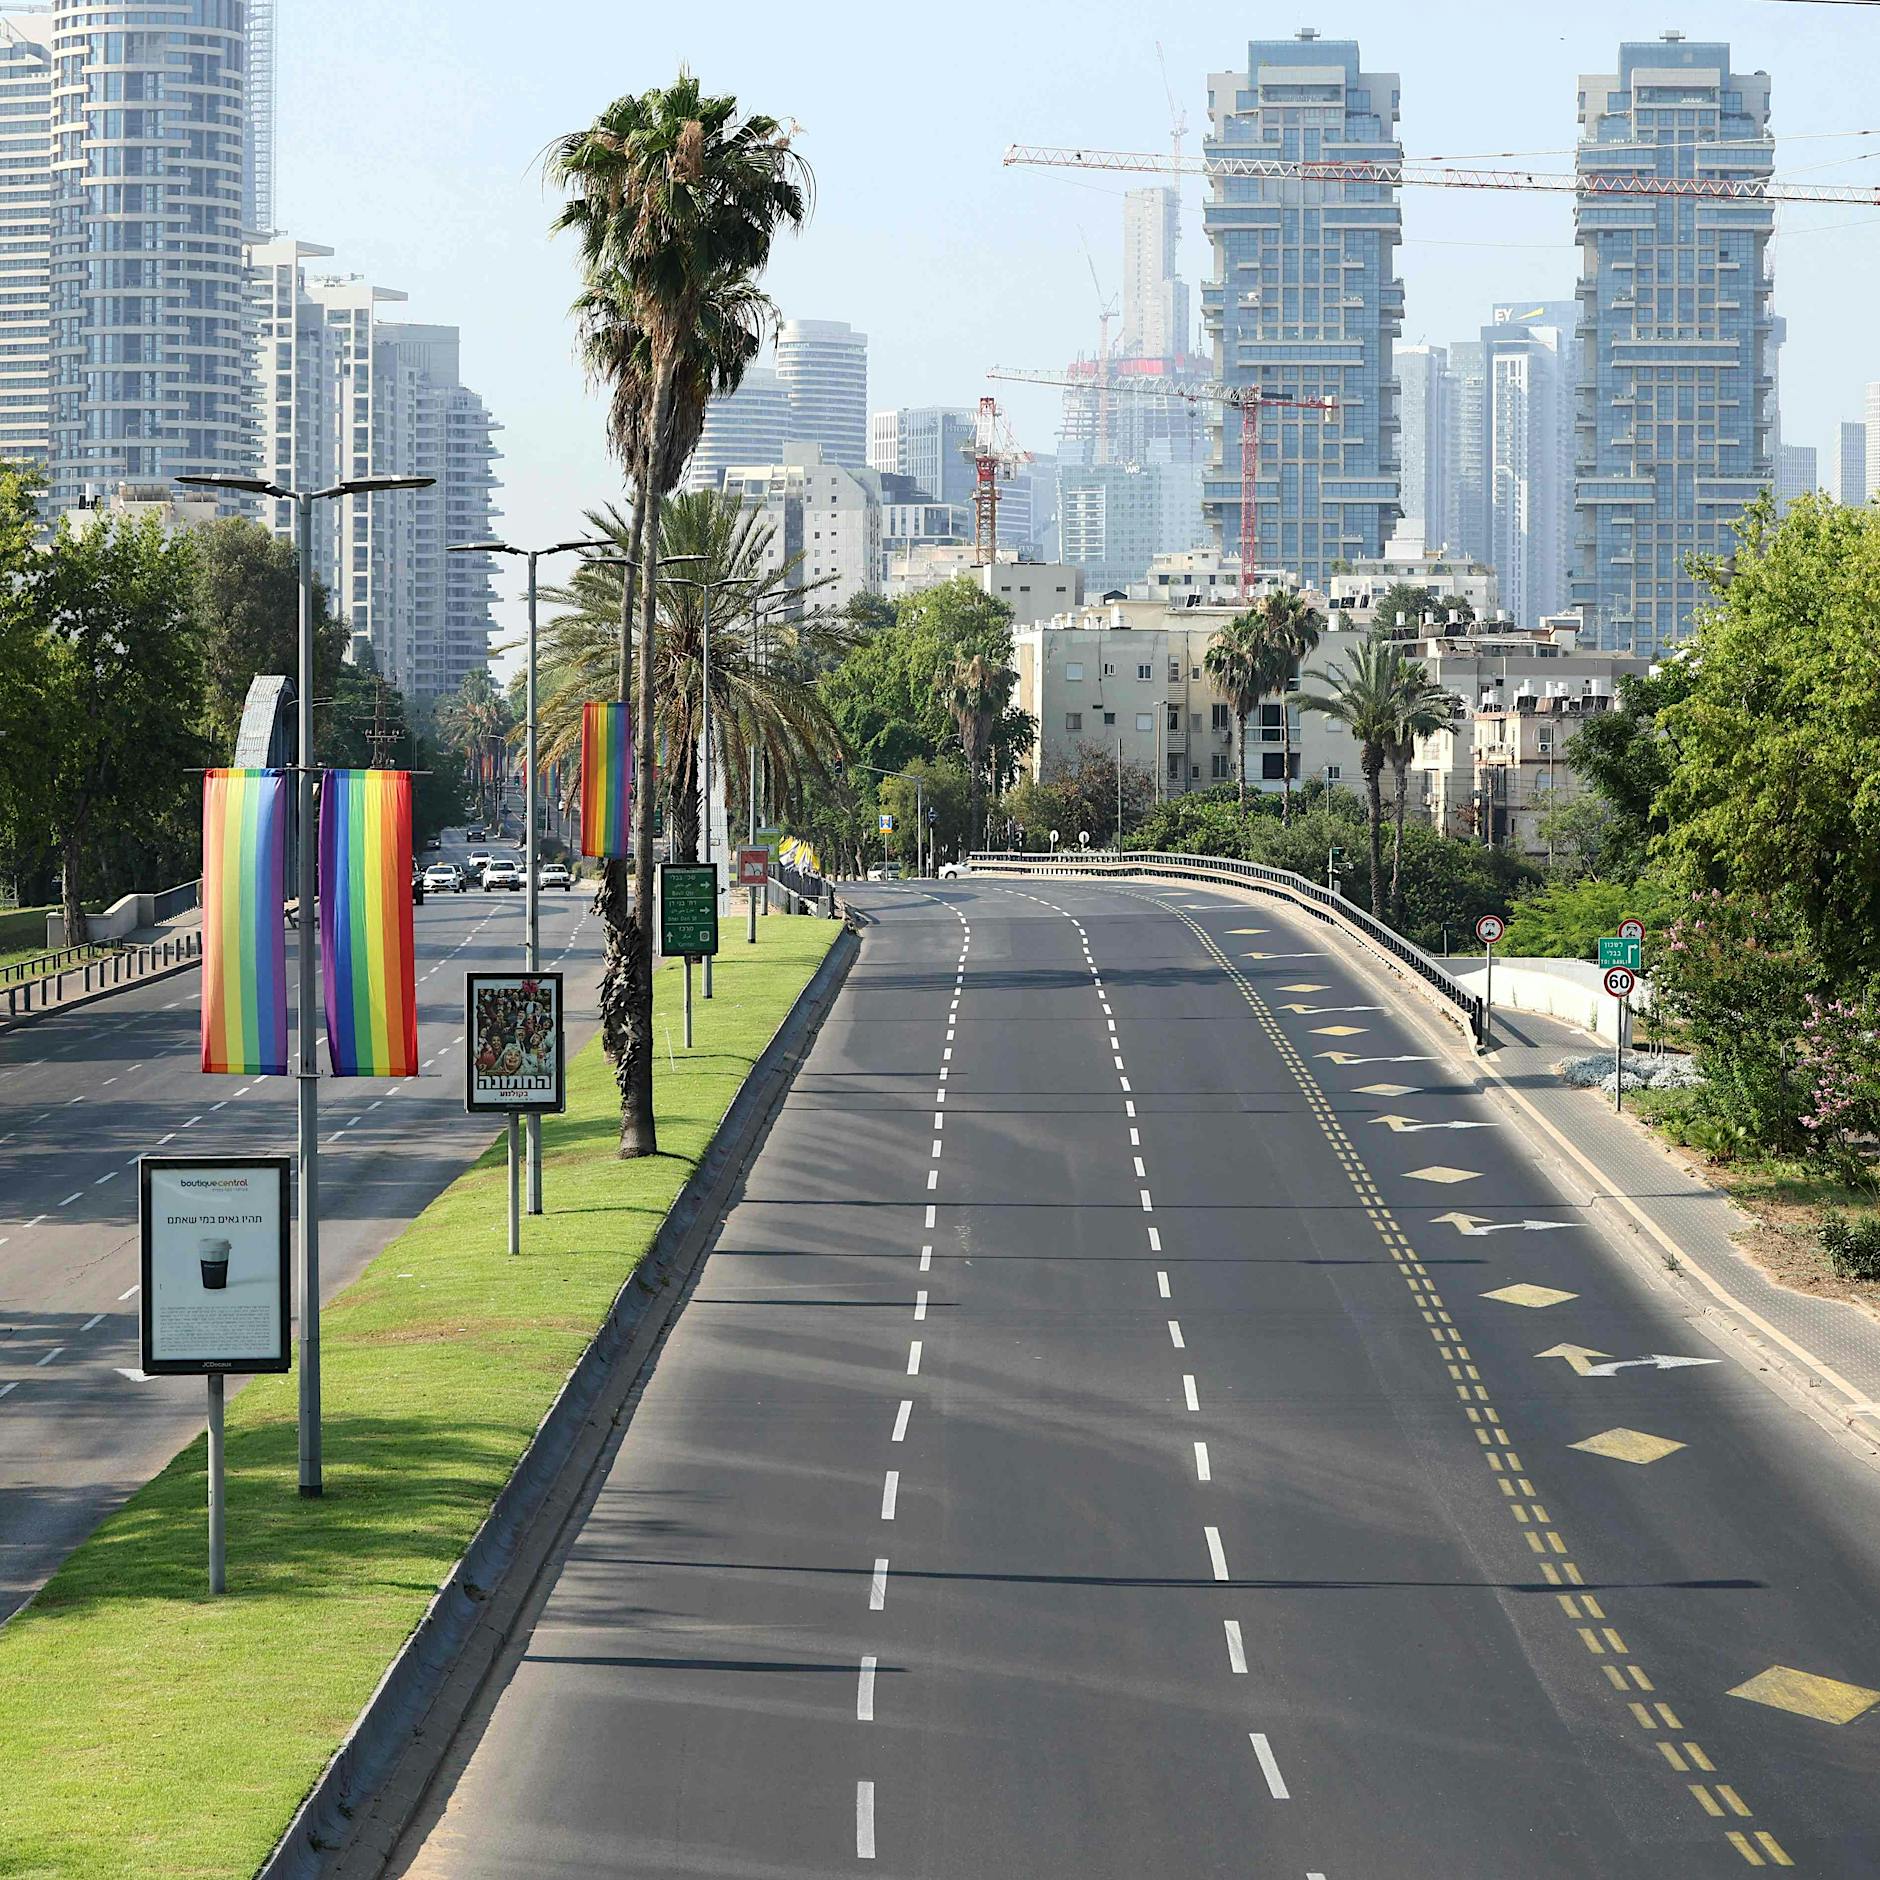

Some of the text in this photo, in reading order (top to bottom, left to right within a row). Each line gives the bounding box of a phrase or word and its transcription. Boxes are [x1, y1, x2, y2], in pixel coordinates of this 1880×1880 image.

[1494, 308, 1514, 322] EY
[1124, 465, 1141, 474] we
[1610, 975, 1629, 988] 60
[478, 1075, 550, 1089] החתונה
[167, 1215, 262, 1225] תהיו גאים במי שאתם
